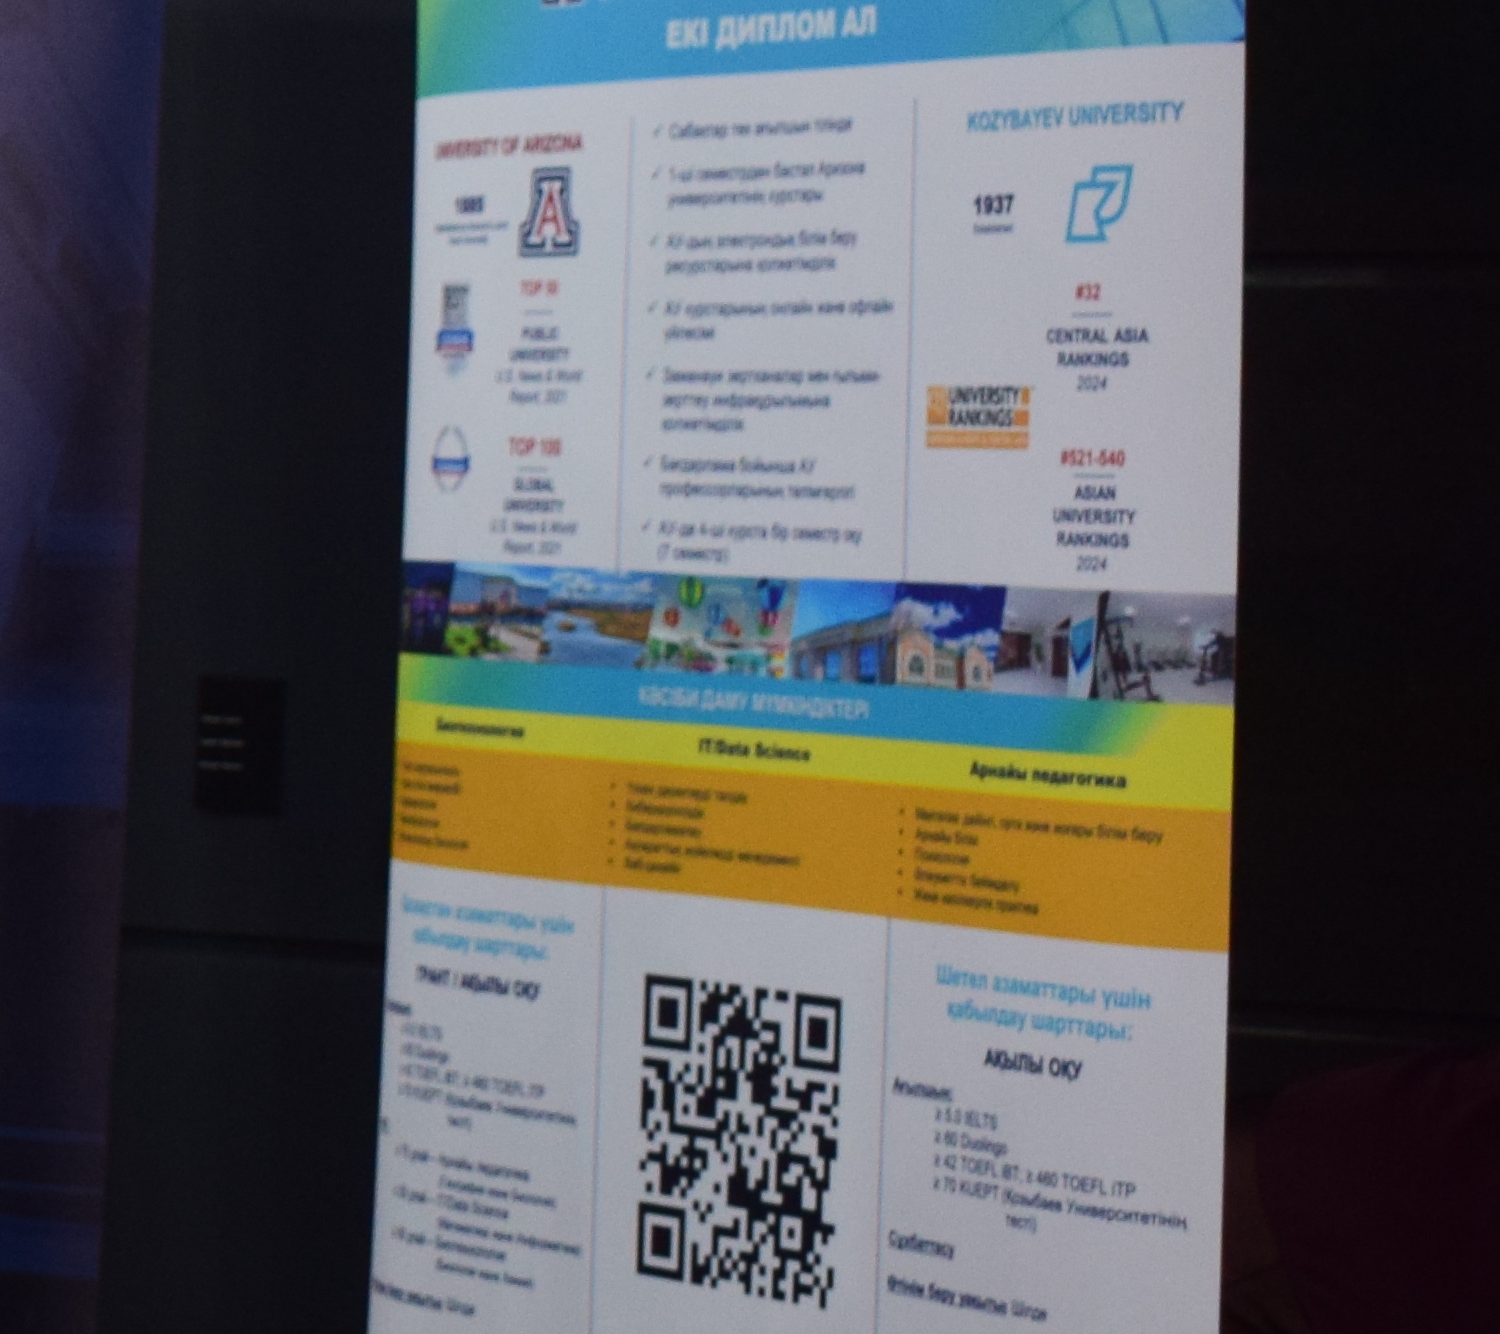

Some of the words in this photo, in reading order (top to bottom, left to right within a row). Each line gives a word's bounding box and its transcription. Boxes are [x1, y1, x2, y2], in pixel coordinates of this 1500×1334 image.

[665, 17, 711, 50] ЕКІ
[716, 8, 836, 52] ДИПЛОМ
[840, 4, 879, 37] АЛ
[966, 106, 1064, 133] KOZYBAYEV
[1068, 100, 1186, 126] UNIVERSITY
[973, 193, 1015, 216] 1937
[1074, 282, 1102, 302] #32
[1046, 328, 1109, 345] CENTRAL
[1113, 327, 1150, 344] ASIA
[1056, 351, 1130, 368] RANKINGS
[1076, 375, 1107, 392] 2024
[948, 385, 1019, 406] UNIVERSITY
[947, 409, 1015, 428] RANKINGS
[1074, 484, 1117, 502] ASIAN
[1052, 509, 1136, 525] UNIVERSITY
[1056, 532, 1130, 549] RANKINGS
[1076, 555, 1107, 572] 2024
[970, 760, 1028, 783] Арнайы
[1032, 769, 1128, 790] педагогика
[993, 971, 1096, 1006] азаматтары
[1101, 986, 1152, 1012] үшін
[1048, 1055, 1083, 1083] ОҚУ
[1062, 1172, 1107, 1196] TOEFL
